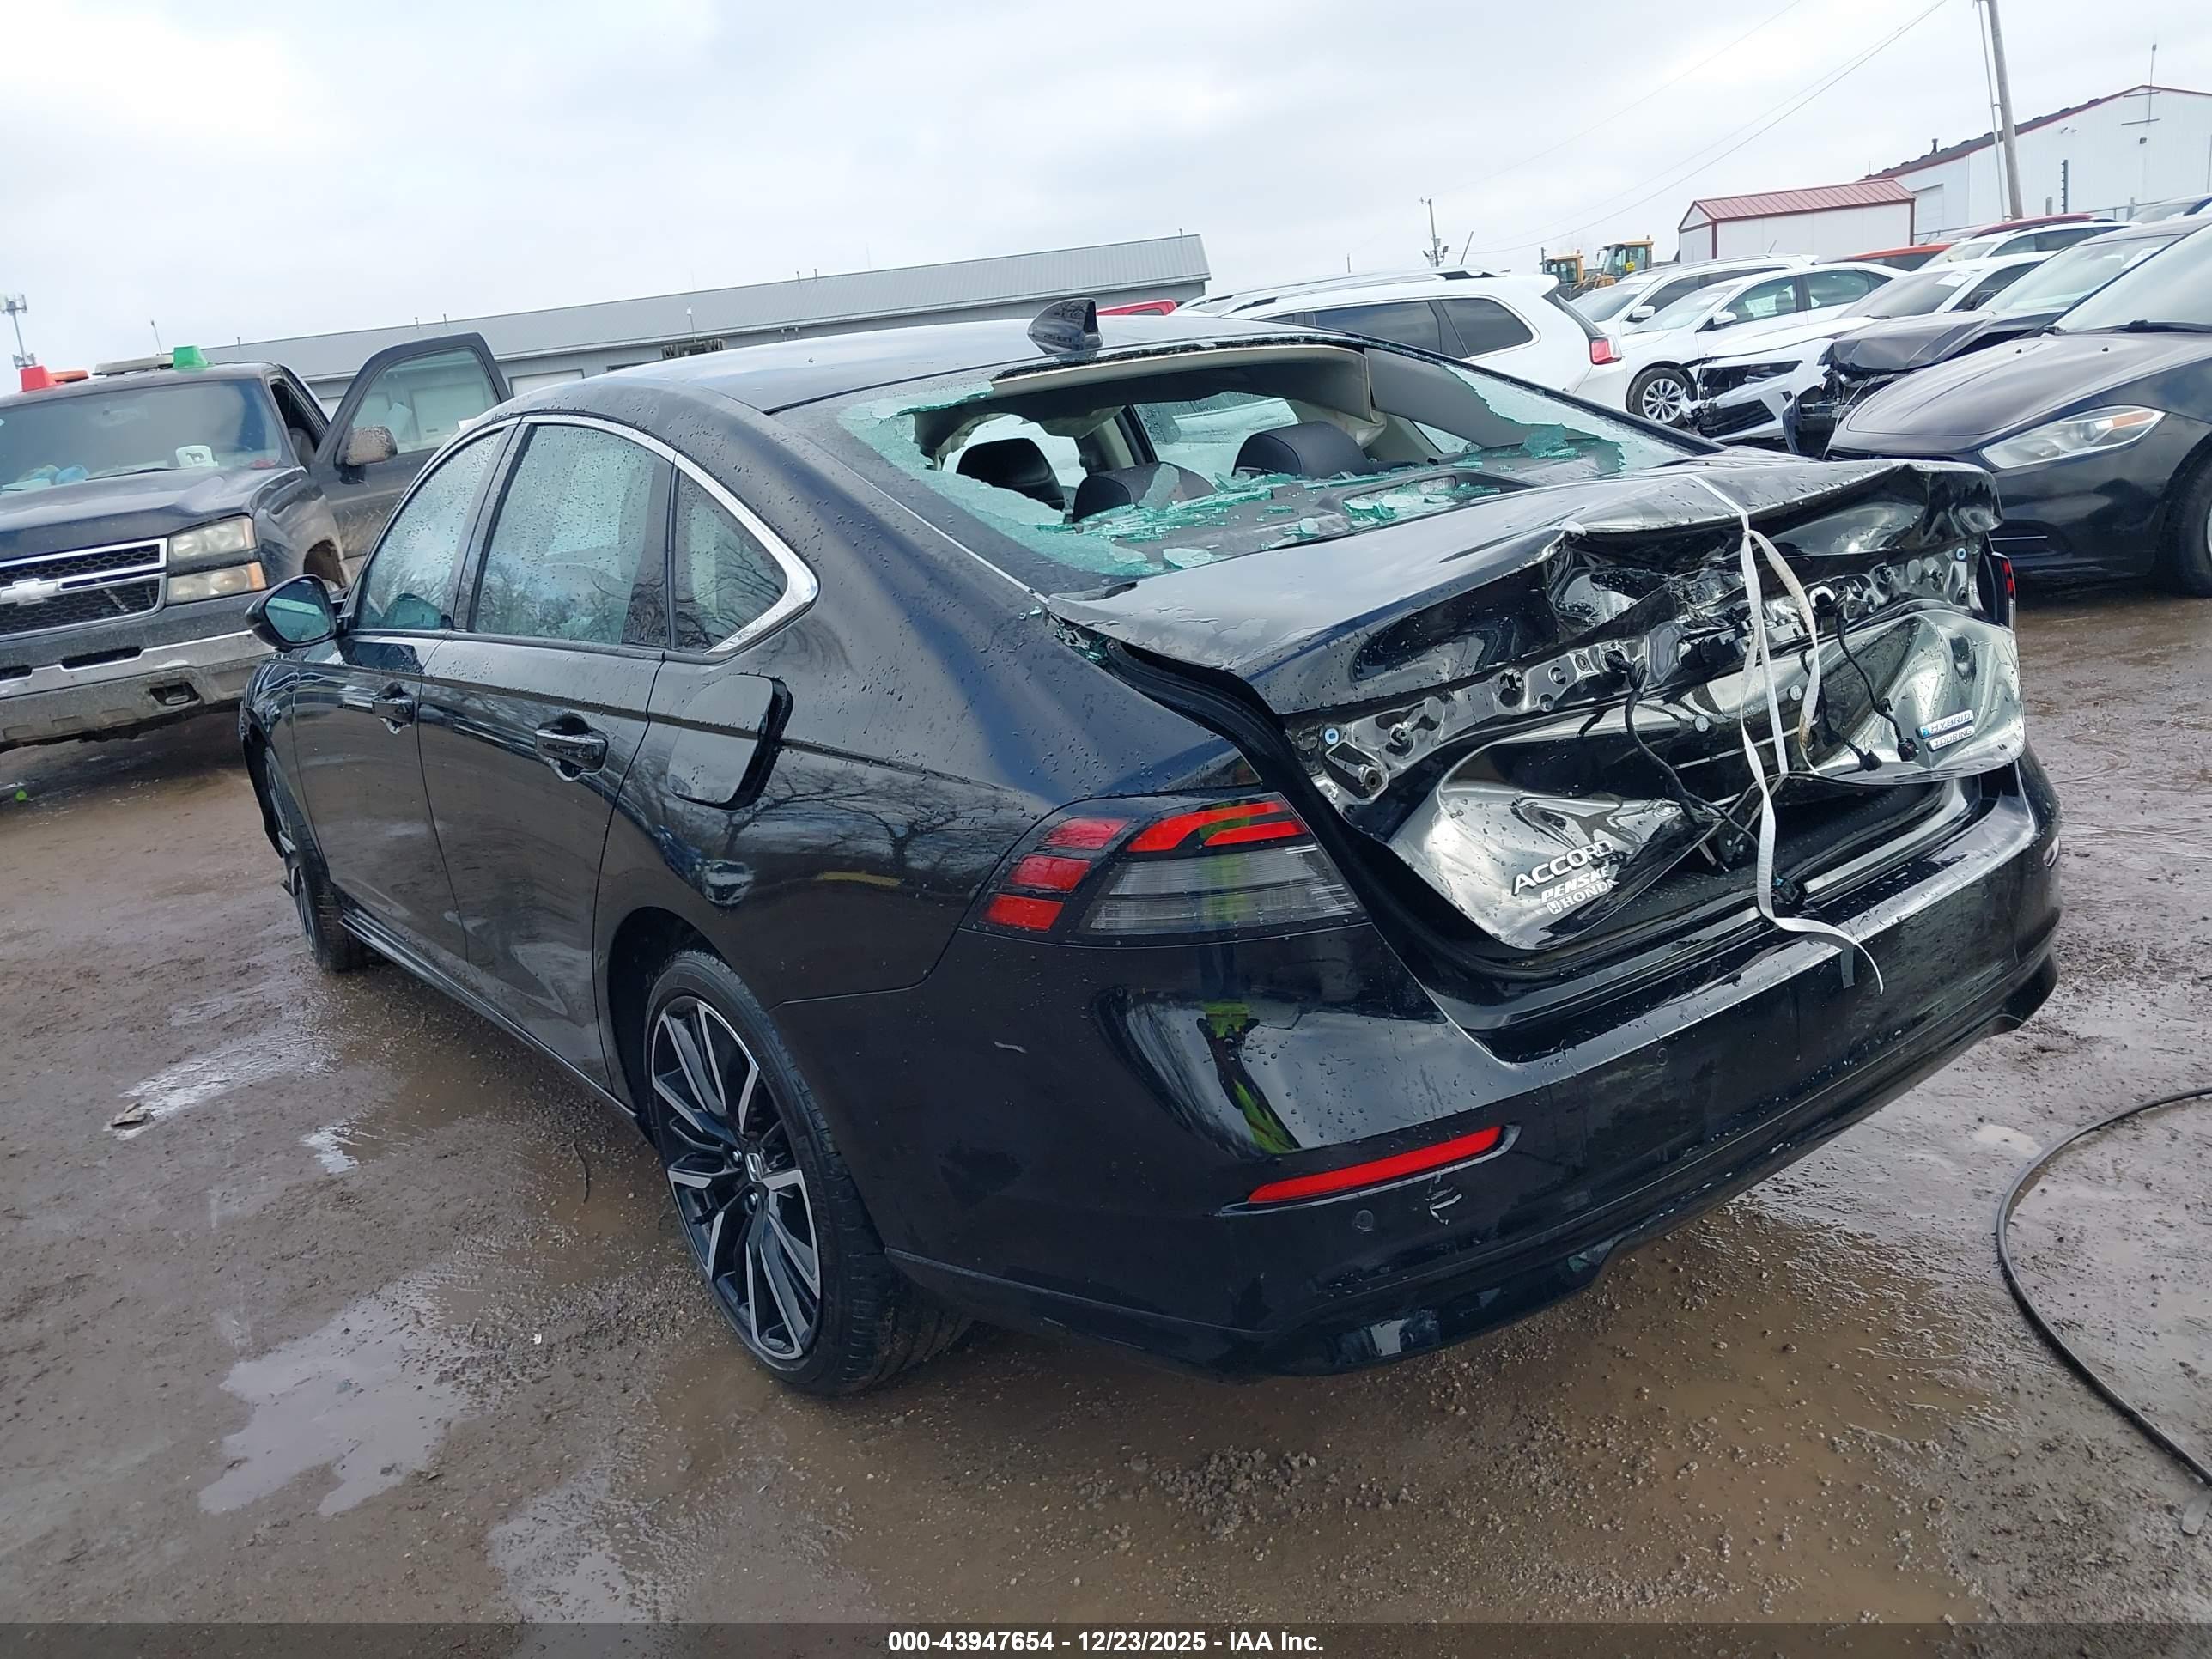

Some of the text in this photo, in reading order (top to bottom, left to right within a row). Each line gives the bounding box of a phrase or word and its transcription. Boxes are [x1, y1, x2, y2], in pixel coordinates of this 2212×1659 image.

[1930, 713, 1972, 733] HYBRID
[1934, 727, 1973, 748] TOURING
[1513, 839, 1613, 895] ACCORD
[1540, 860, 1610, 903] PENSKE
[1560, 878, 1620, 908] HONDA
